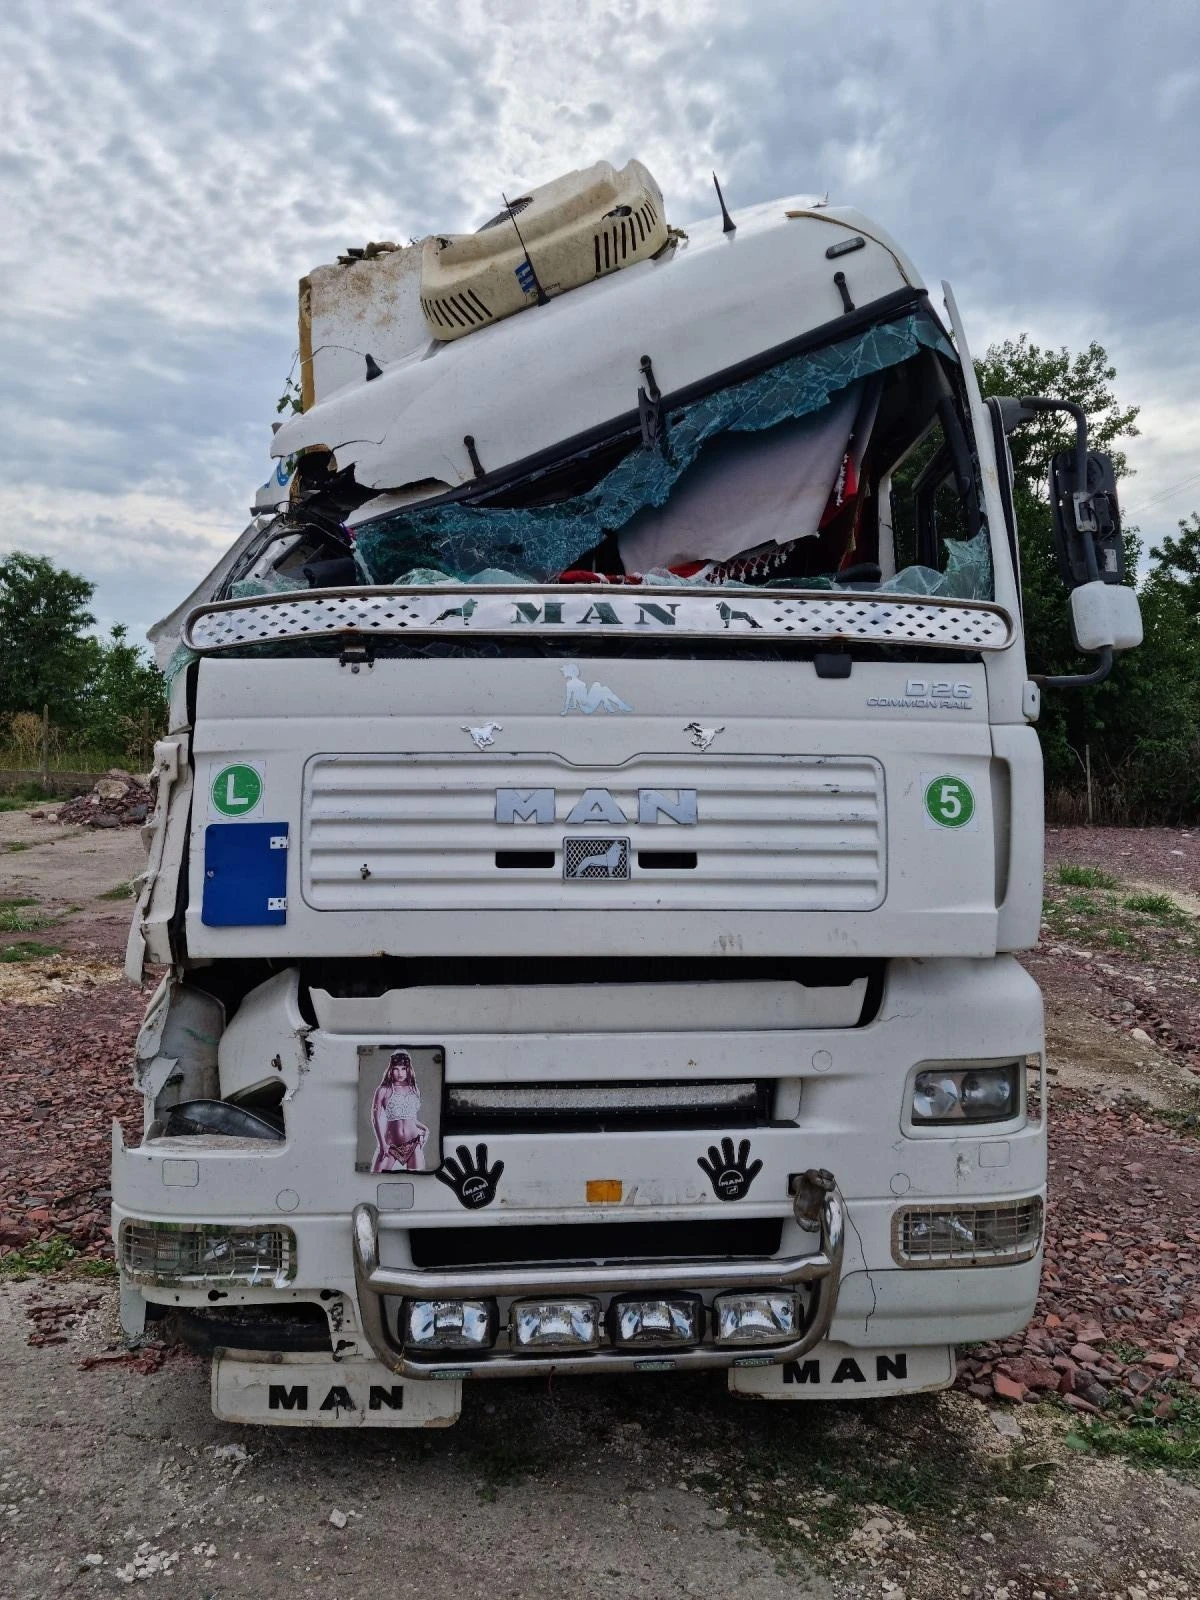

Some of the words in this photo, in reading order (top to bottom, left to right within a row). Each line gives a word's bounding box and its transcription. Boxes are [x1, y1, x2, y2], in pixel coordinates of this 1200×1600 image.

[511, 602, 679, 626] MAN
[866, 697, 938, 710] COMMON
[939, 699, 973, 711] RAIL
[226, 774, 249, 806] L
[495, 787, 699, 825] MAN
[939, 784, 962, 819] 5
[783, 1353, 908, 1385] MAN
[268, 1384, 405, 1412] MAN
